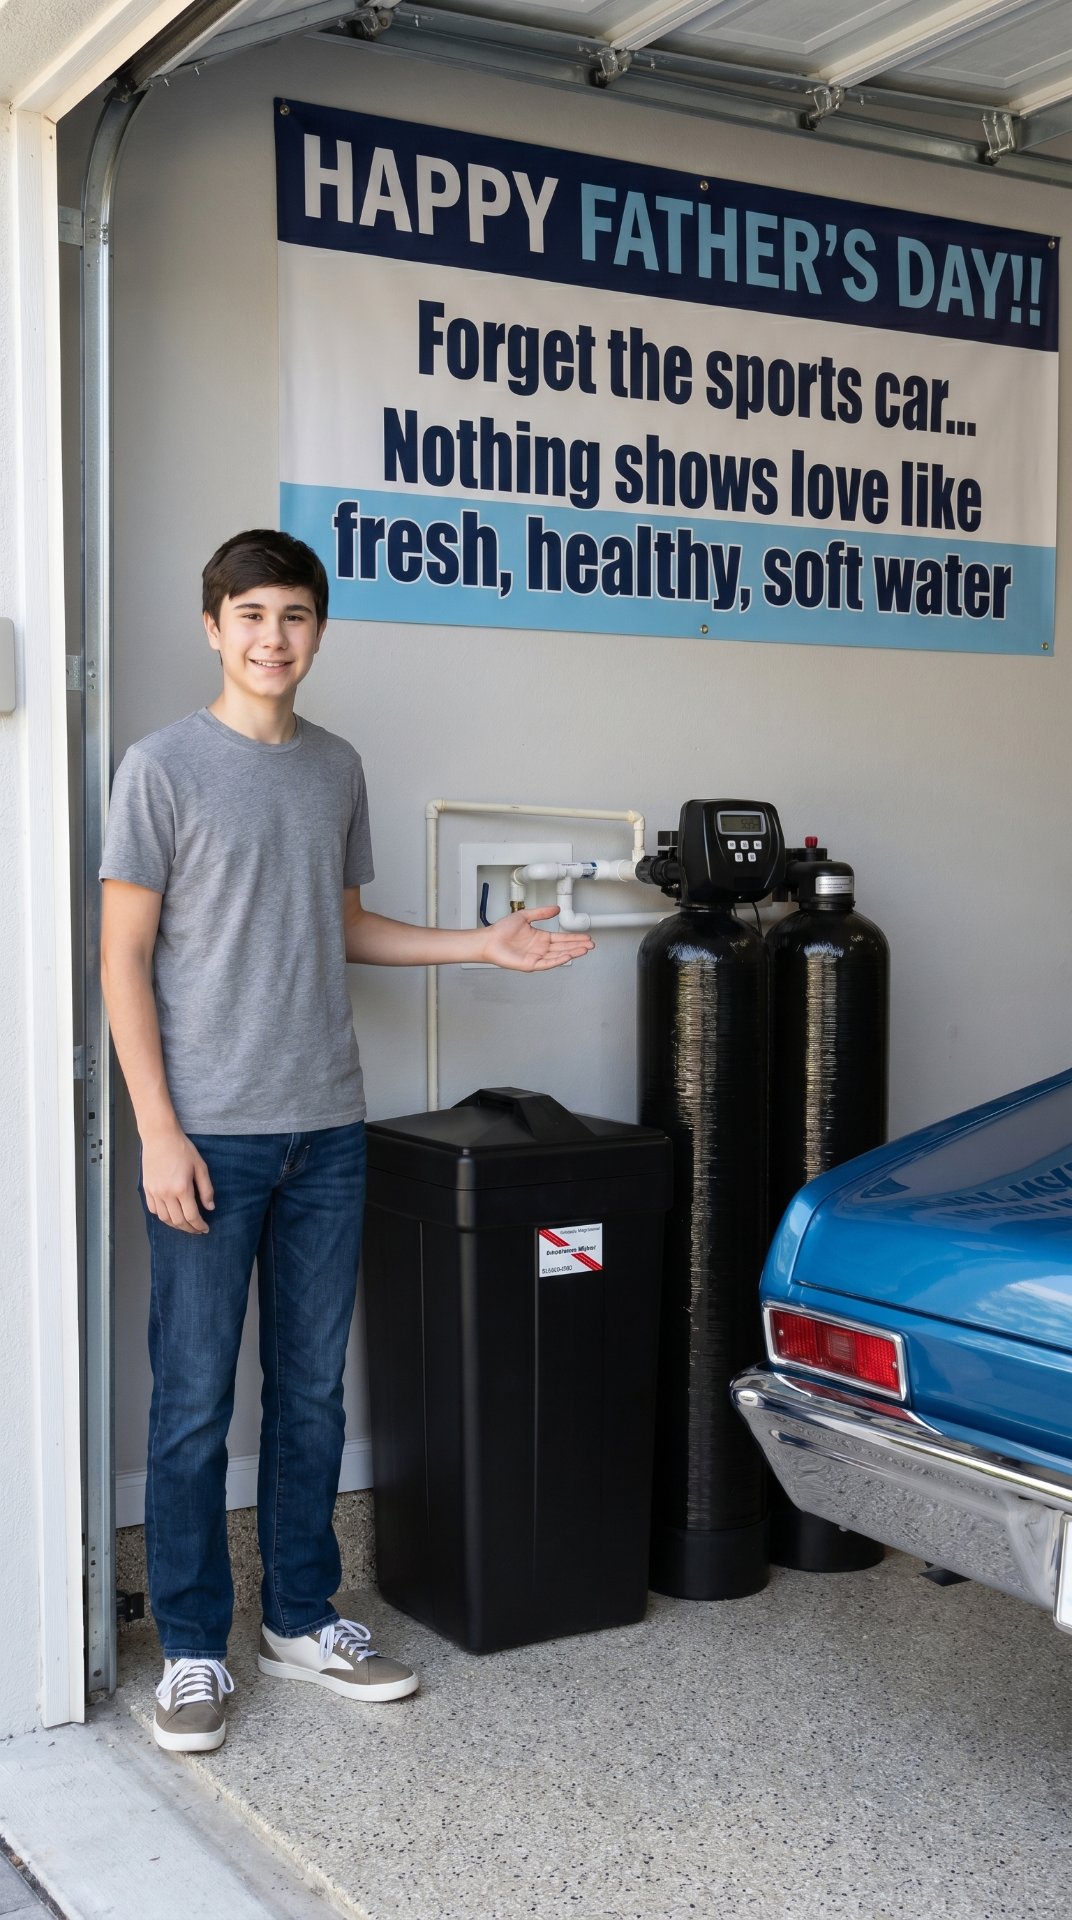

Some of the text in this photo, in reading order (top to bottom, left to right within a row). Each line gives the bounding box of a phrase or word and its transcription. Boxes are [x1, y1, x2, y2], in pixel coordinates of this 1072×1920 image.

[304, 134, 558, 253] HAPPY
[897, 237, 1043, 326] DAY!!
[419, 300, 976, 436] Forget the sports car...
[384, 408, 981, 532] Nothing shows love like
[333, 500, 1013, 620] fresh, healthy, soft water
